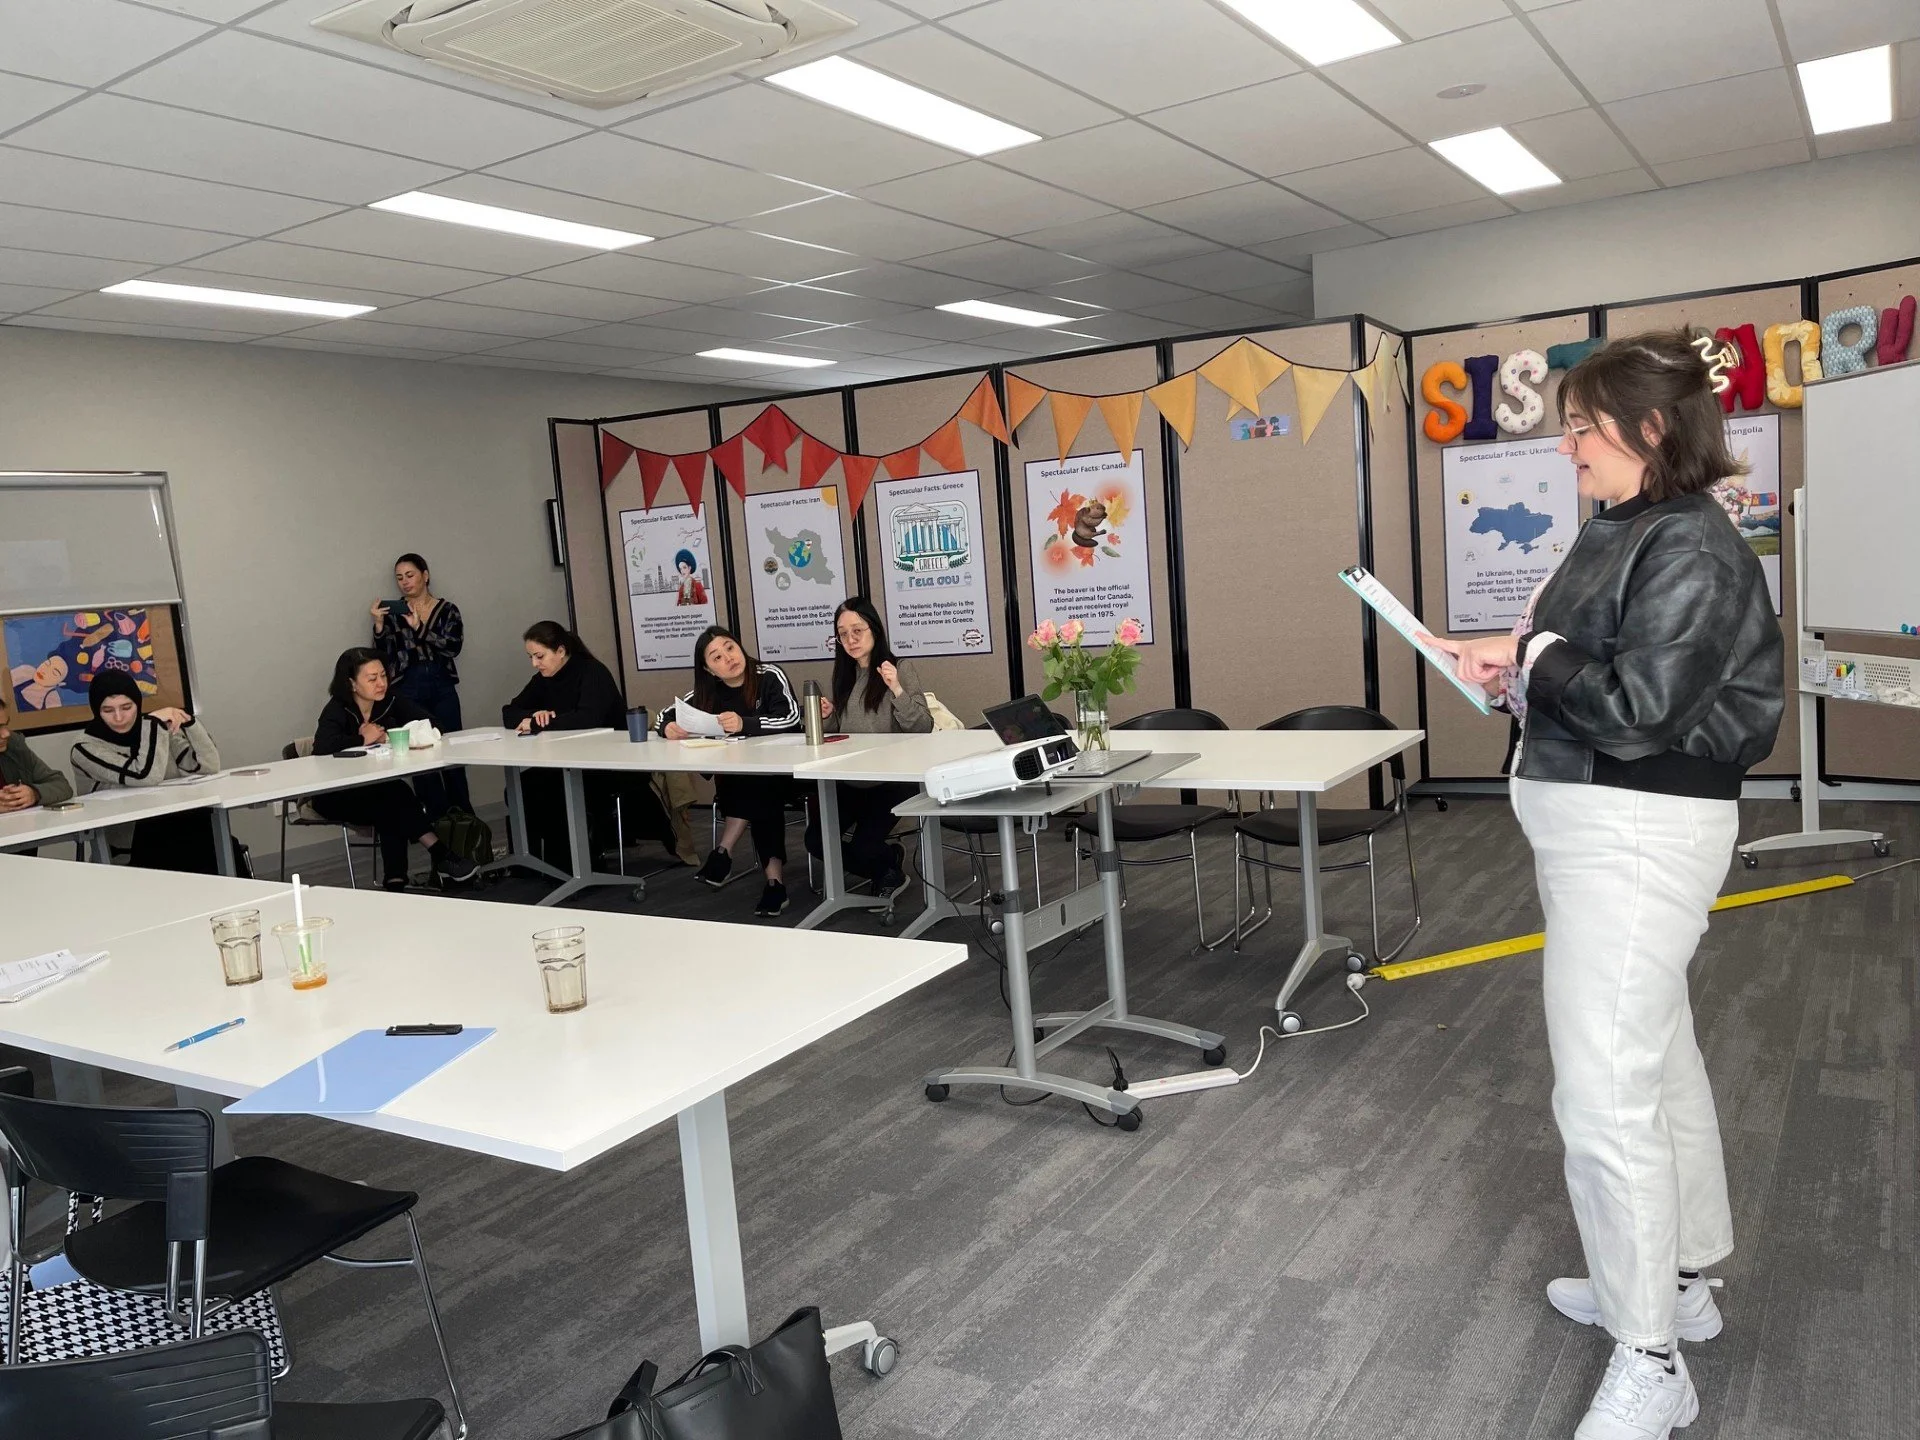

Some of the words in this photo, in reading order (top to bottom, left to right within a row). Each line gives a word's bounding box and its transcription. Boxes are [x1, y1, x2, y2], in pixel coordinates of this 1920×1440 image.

[1459, 452, 1503, 462] Spectacular
[1041, 468, 1078, 477] Spectacular
[889, 487, 922, 497] Spectacular
[760, 501, 791, 509] Spectacular
[631, 517, 659, 525] Spectacular
[937, 575, 960, 585] σου
